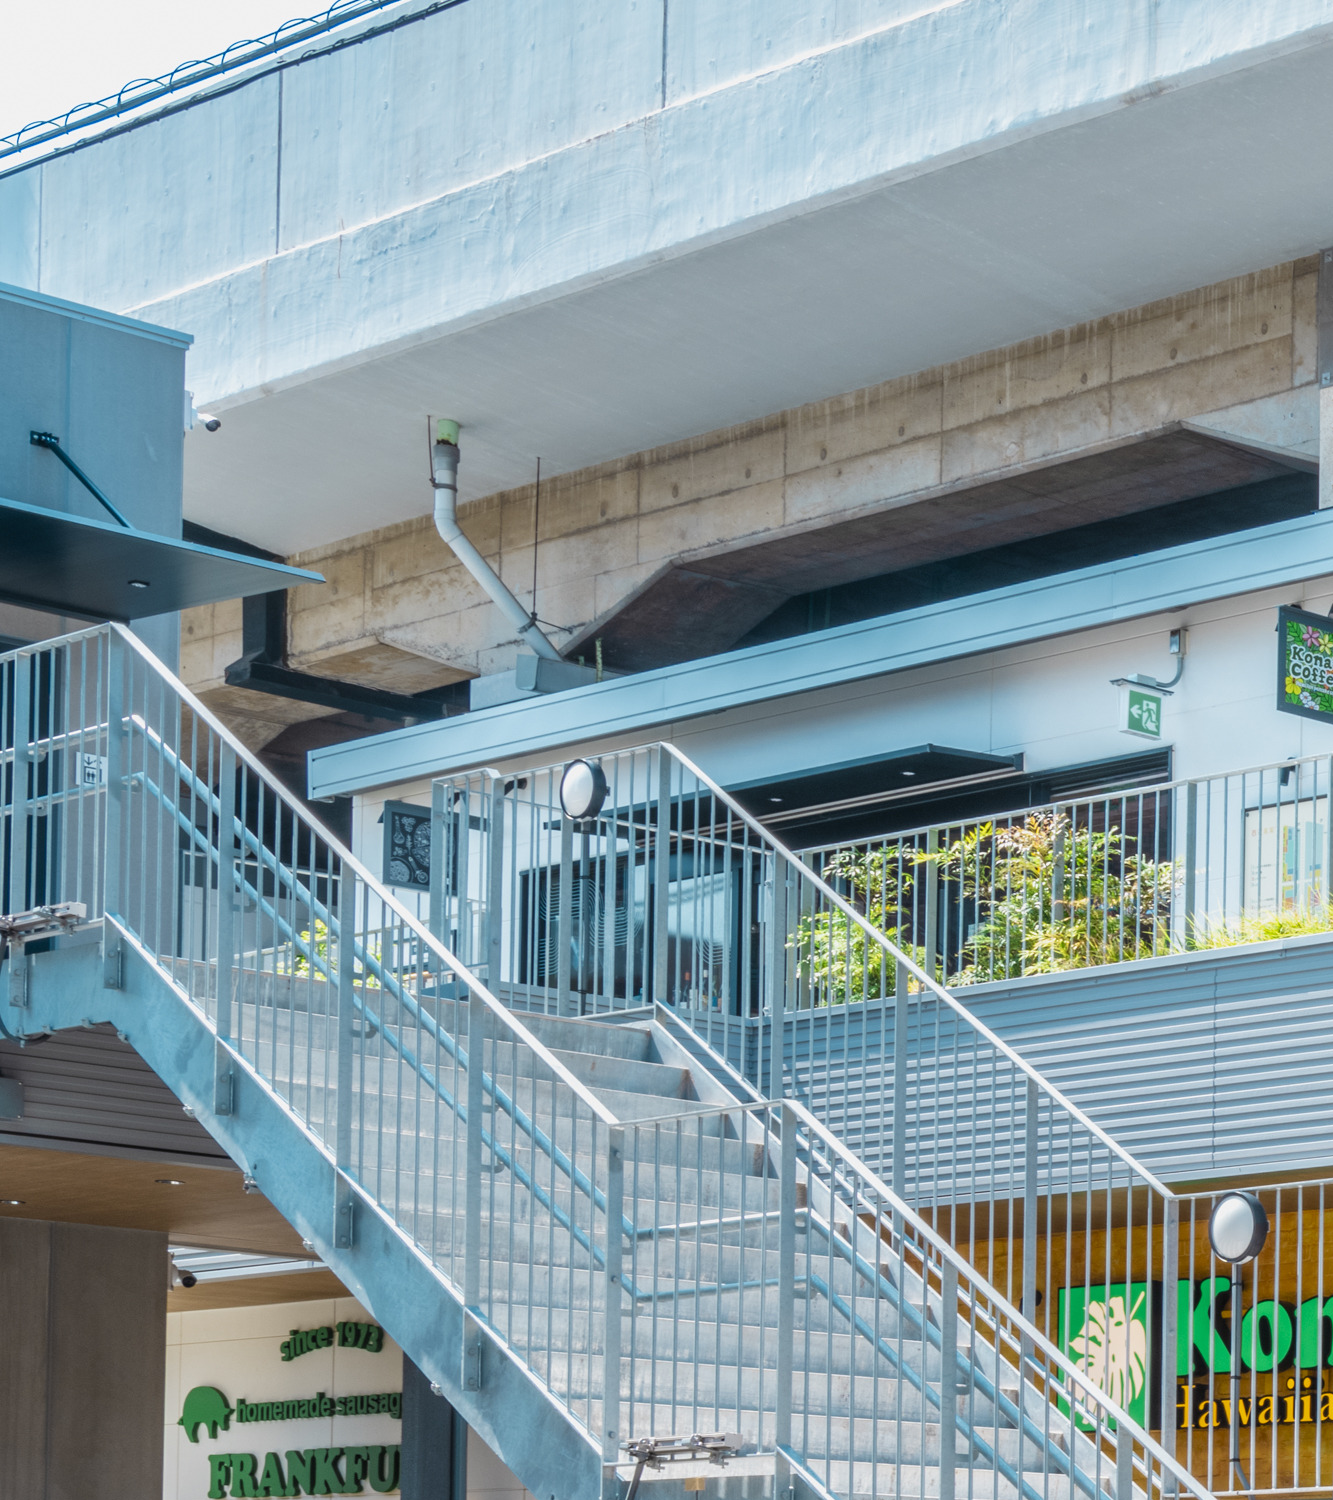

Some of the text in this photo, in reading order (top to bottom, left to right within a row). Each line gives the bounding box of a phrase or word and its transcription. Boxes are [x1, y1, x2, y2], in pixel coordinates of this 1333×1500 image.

[280, 1322, 384, 1361] since 1973
[236, 1391, 402, 1423] homemade sausag
[208, 1445, 400, 1499] FRANKFU
